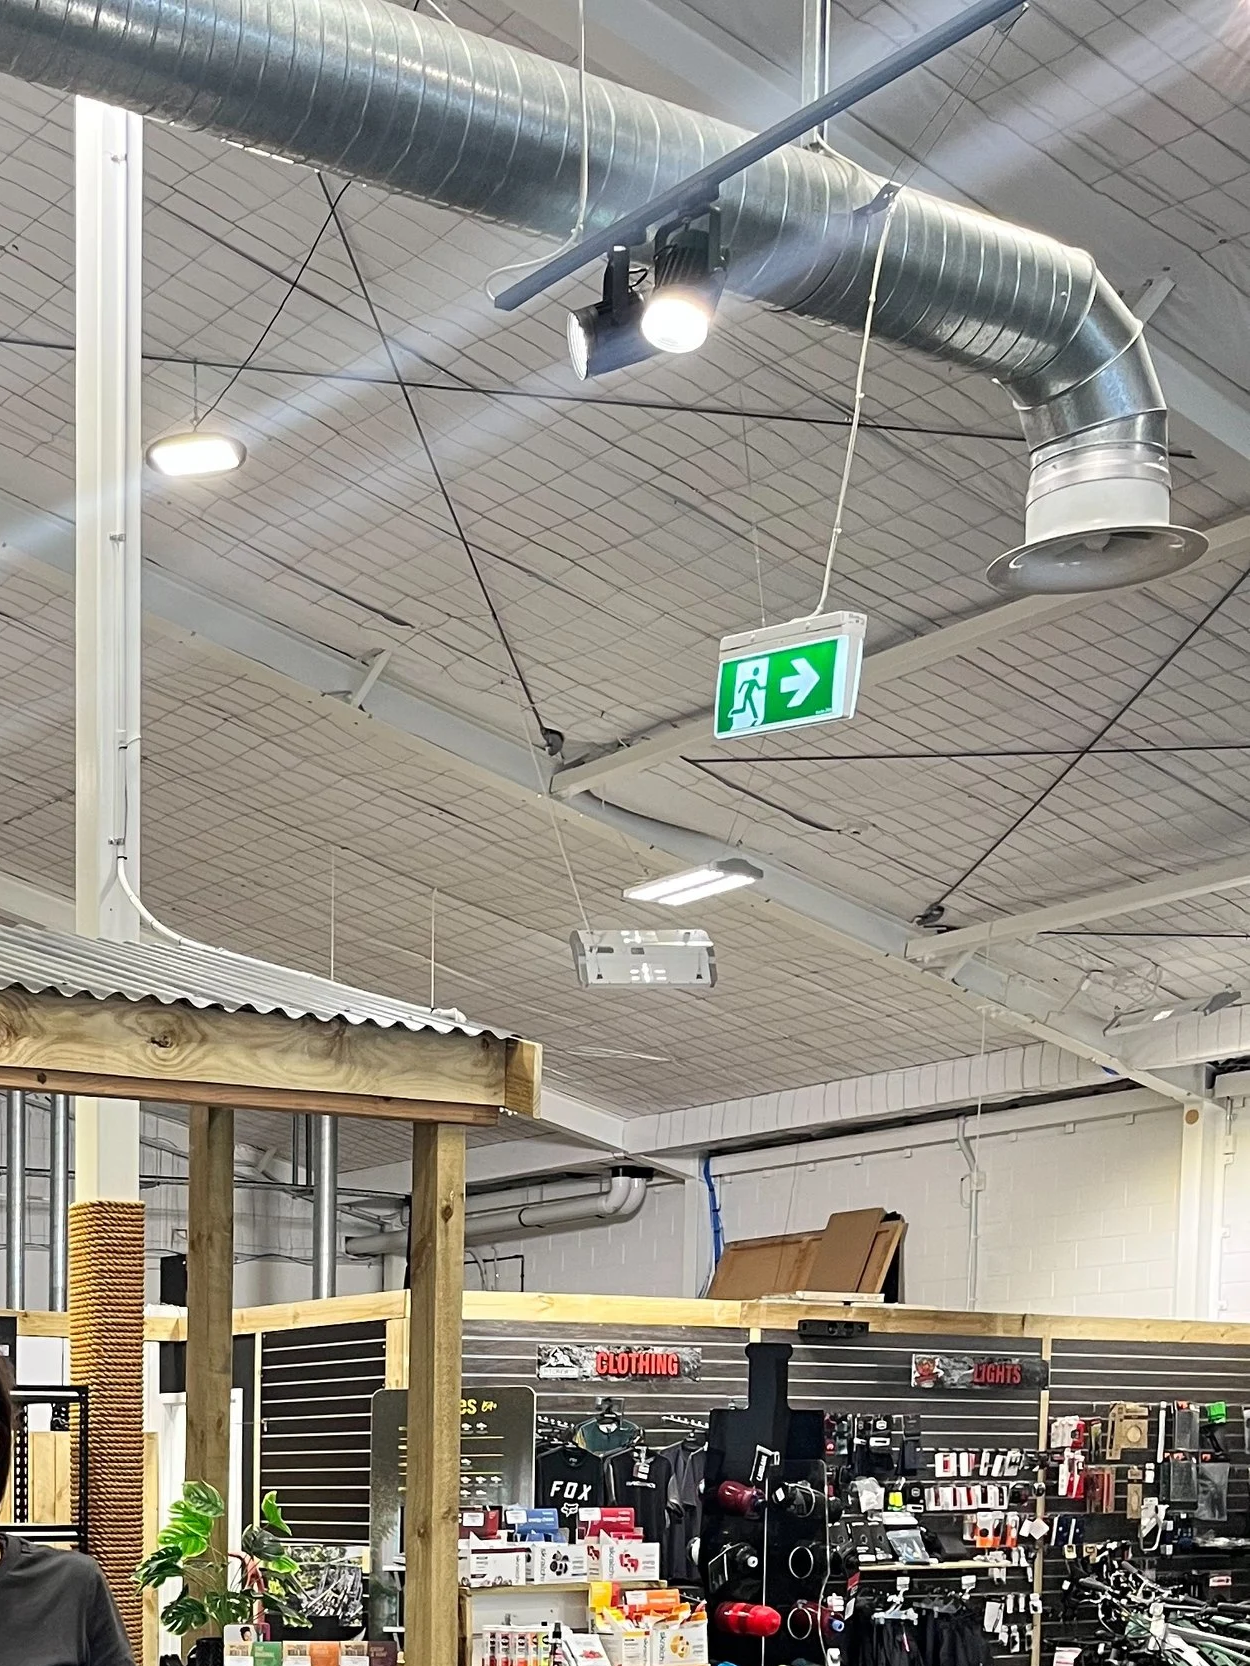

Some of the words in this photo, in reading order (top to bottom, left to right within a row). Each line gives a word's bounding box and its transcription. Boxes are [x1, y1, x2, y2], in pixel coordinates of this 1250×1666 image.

[595, 1351, 680, 1376] CLOTHING
[973, 1363, 1023, 1384] LIGHTS
[460, 1398, 477, 1415] es
[550, 1480, 592, 1501] FOX
